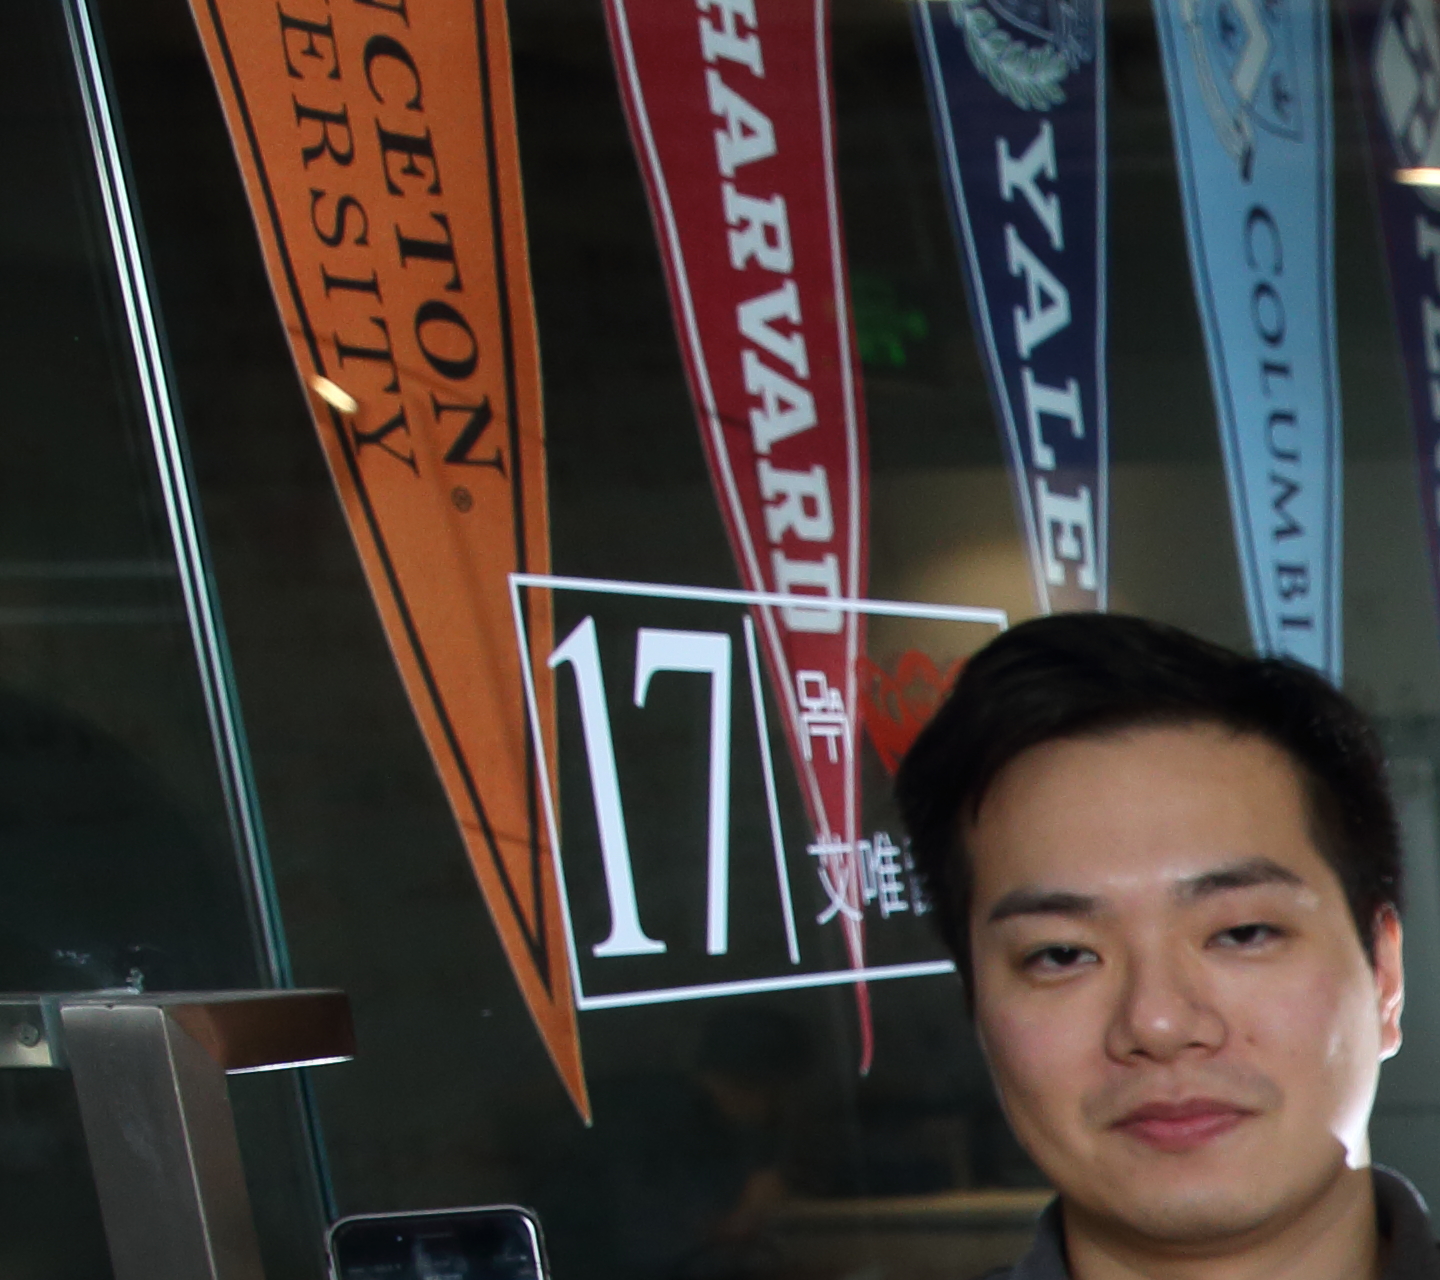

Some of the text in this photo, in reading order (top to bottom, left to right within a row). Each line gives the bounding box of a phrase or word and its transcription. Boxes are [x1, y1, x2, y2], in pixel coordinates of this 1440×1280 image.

[275, 0, 421, 479] ERSITY
[354, 0, 508, 478] CETON
[696, 0, 842, 635] HARVARD
[997, 121, 1098, 590] YALE
[1242, 204, 1316, 648] COLUMBI
[547, 615, 731, 956] 17
